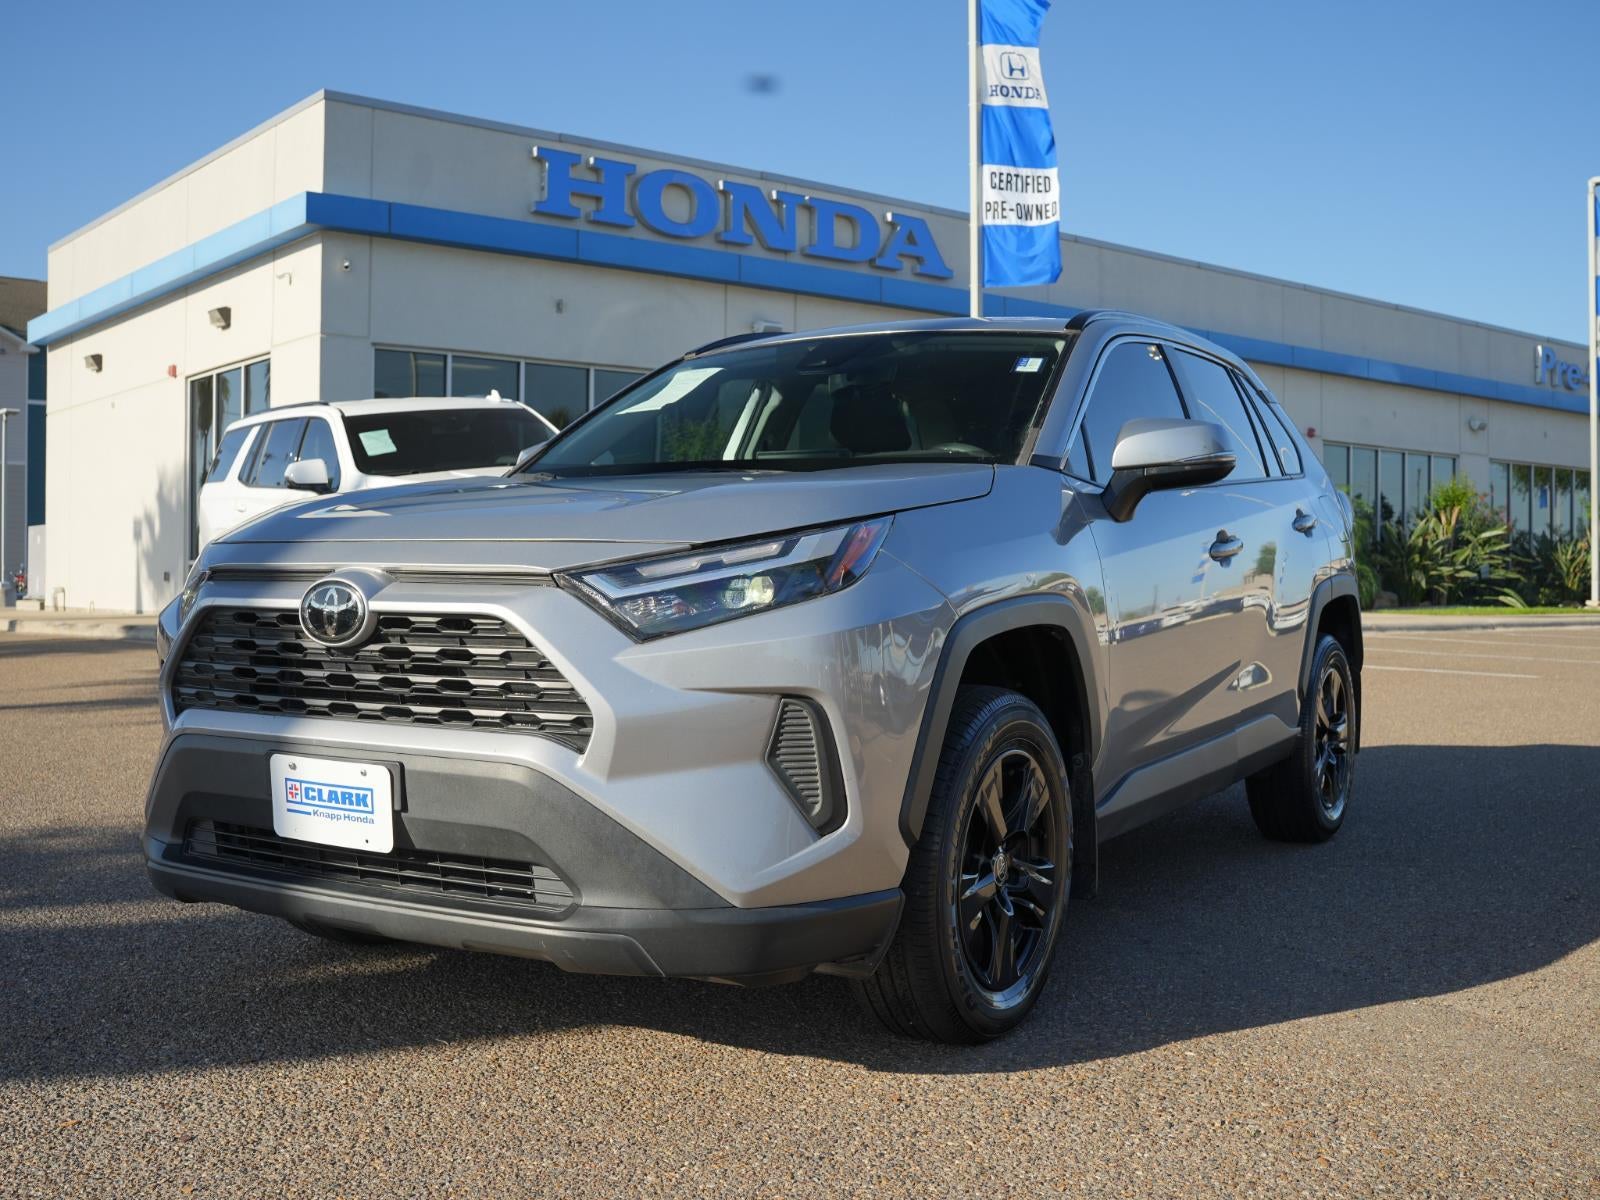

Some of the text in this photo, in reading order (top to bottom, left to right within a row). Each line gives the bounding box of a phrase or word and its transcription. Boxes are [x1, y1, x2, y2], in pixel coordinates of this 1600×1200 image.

[990, 171, 1051, 193] CERTIFIED
[530, 146, 952, 279] HONDA
[985, 200, 1057, 221] PRE-OWNED
[304, 786, 369, 808] CLARK
[312, 809, 375, 824] Knapp Honda
